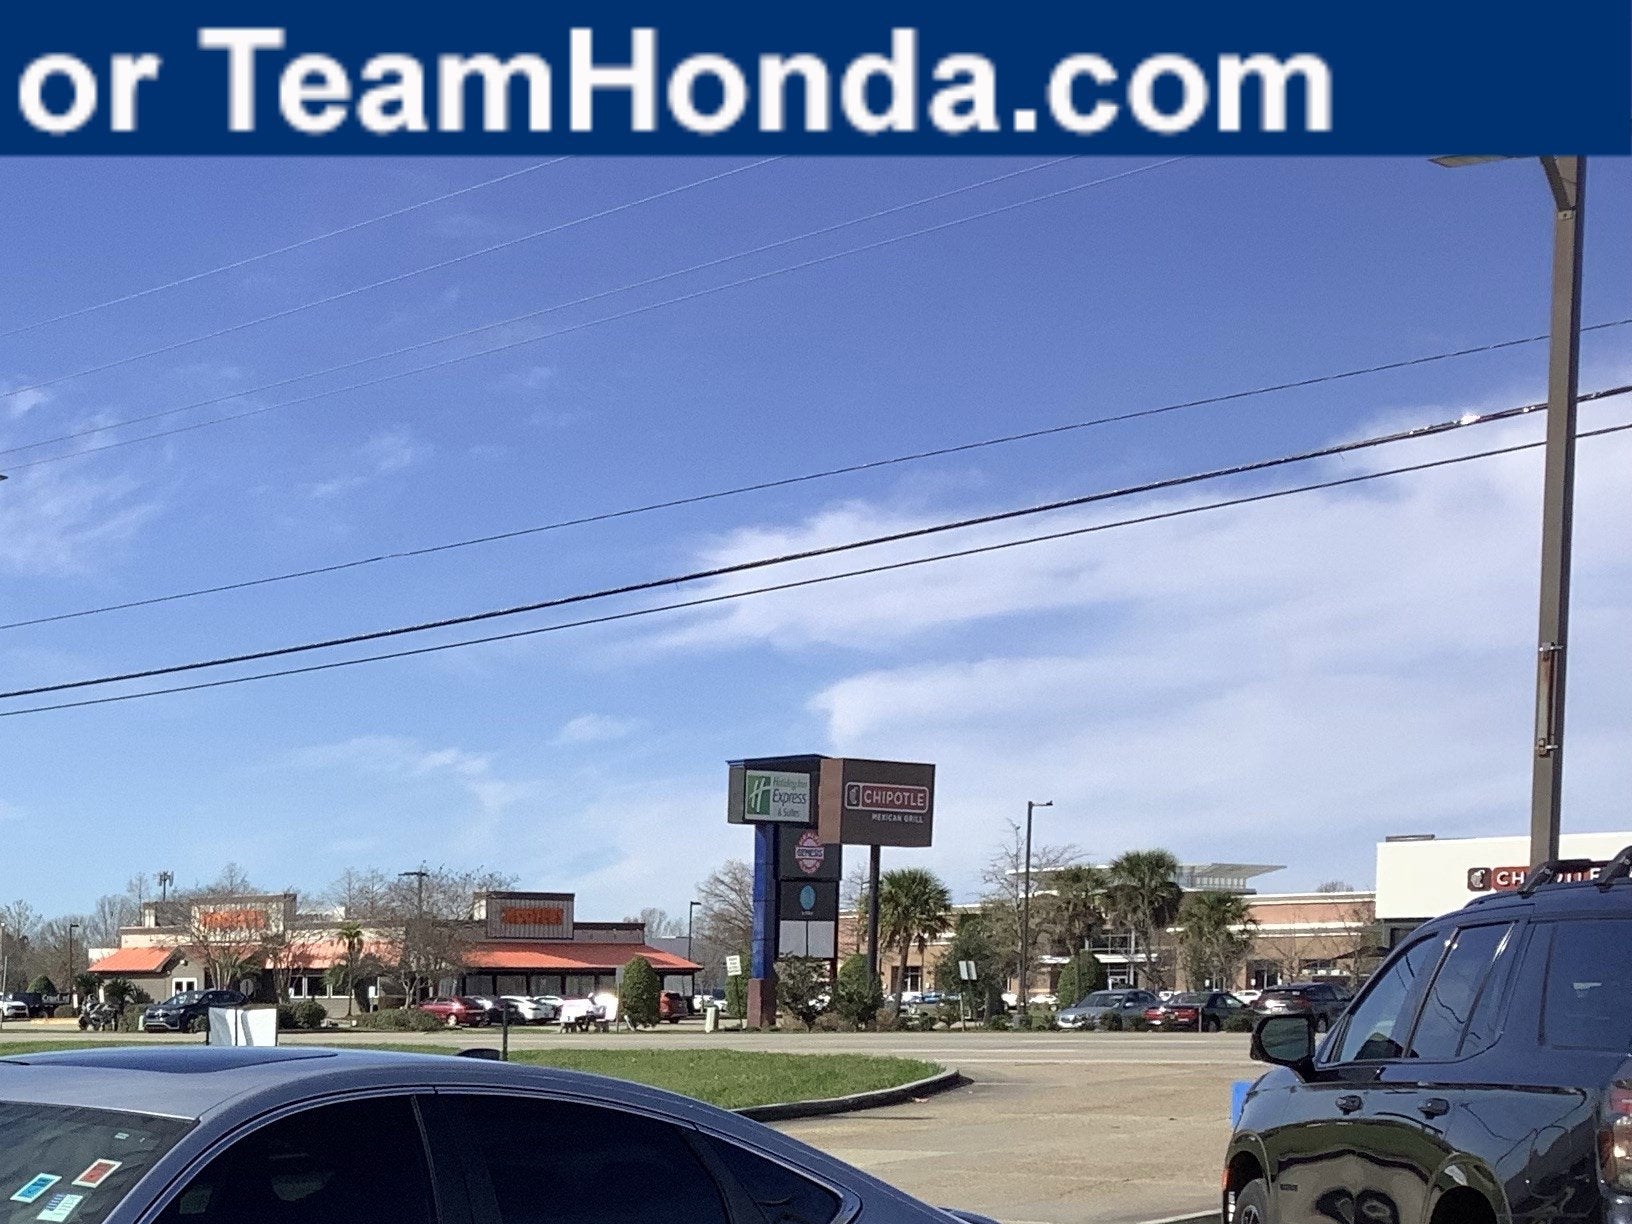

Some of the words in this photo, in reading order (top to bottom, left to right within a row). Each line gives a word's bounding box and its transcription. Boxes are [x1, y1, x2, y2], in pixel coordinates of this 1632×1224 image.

[772, 788, 807, 806] Express
[864, 789, 925, 807] CHIPOTLE
[872, 813, 902, 823] MEXICAN
[904, 815, 924, 824] GRILL
